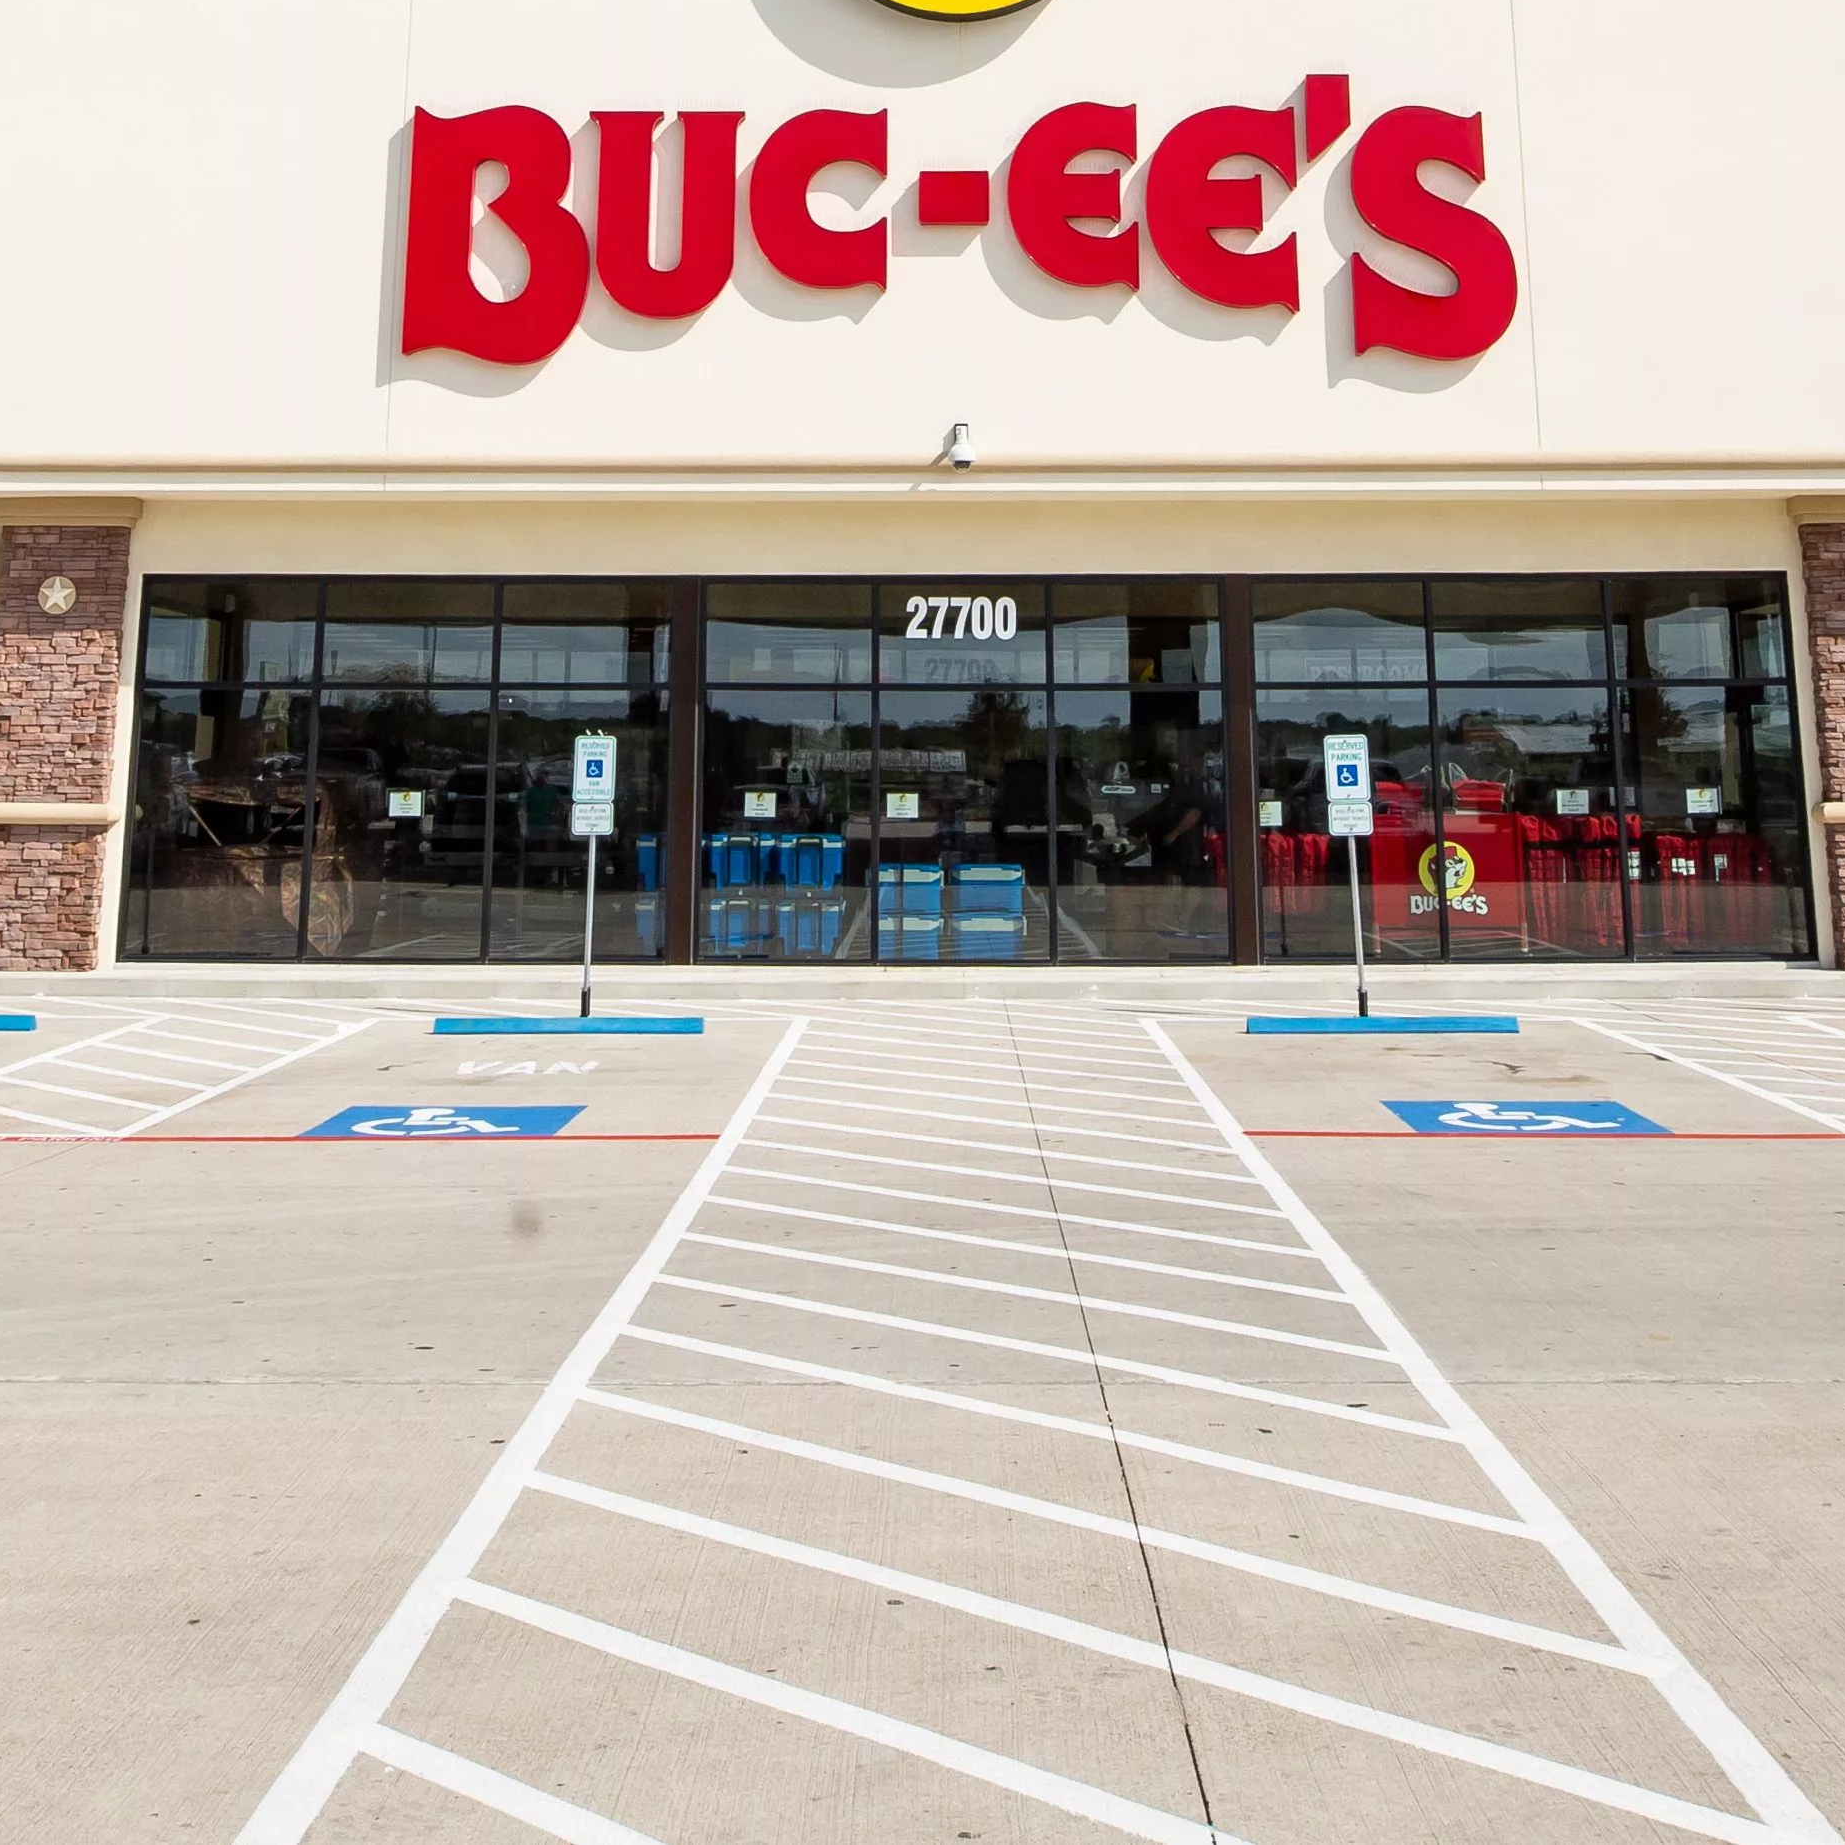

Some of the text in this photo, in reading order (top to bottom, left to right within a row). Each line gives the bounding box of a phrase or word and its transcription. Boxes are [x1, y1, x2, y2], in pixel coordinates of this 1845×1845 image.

[402, 73, 1519, 365] BUC-EE'S
[905, 596, 1017, 641] 27700
[1328, 741, 1364, 750] RESERVED
[1331, 753, 1363, 761] PARKING
[456, 1060, 600, 1075] VAN
